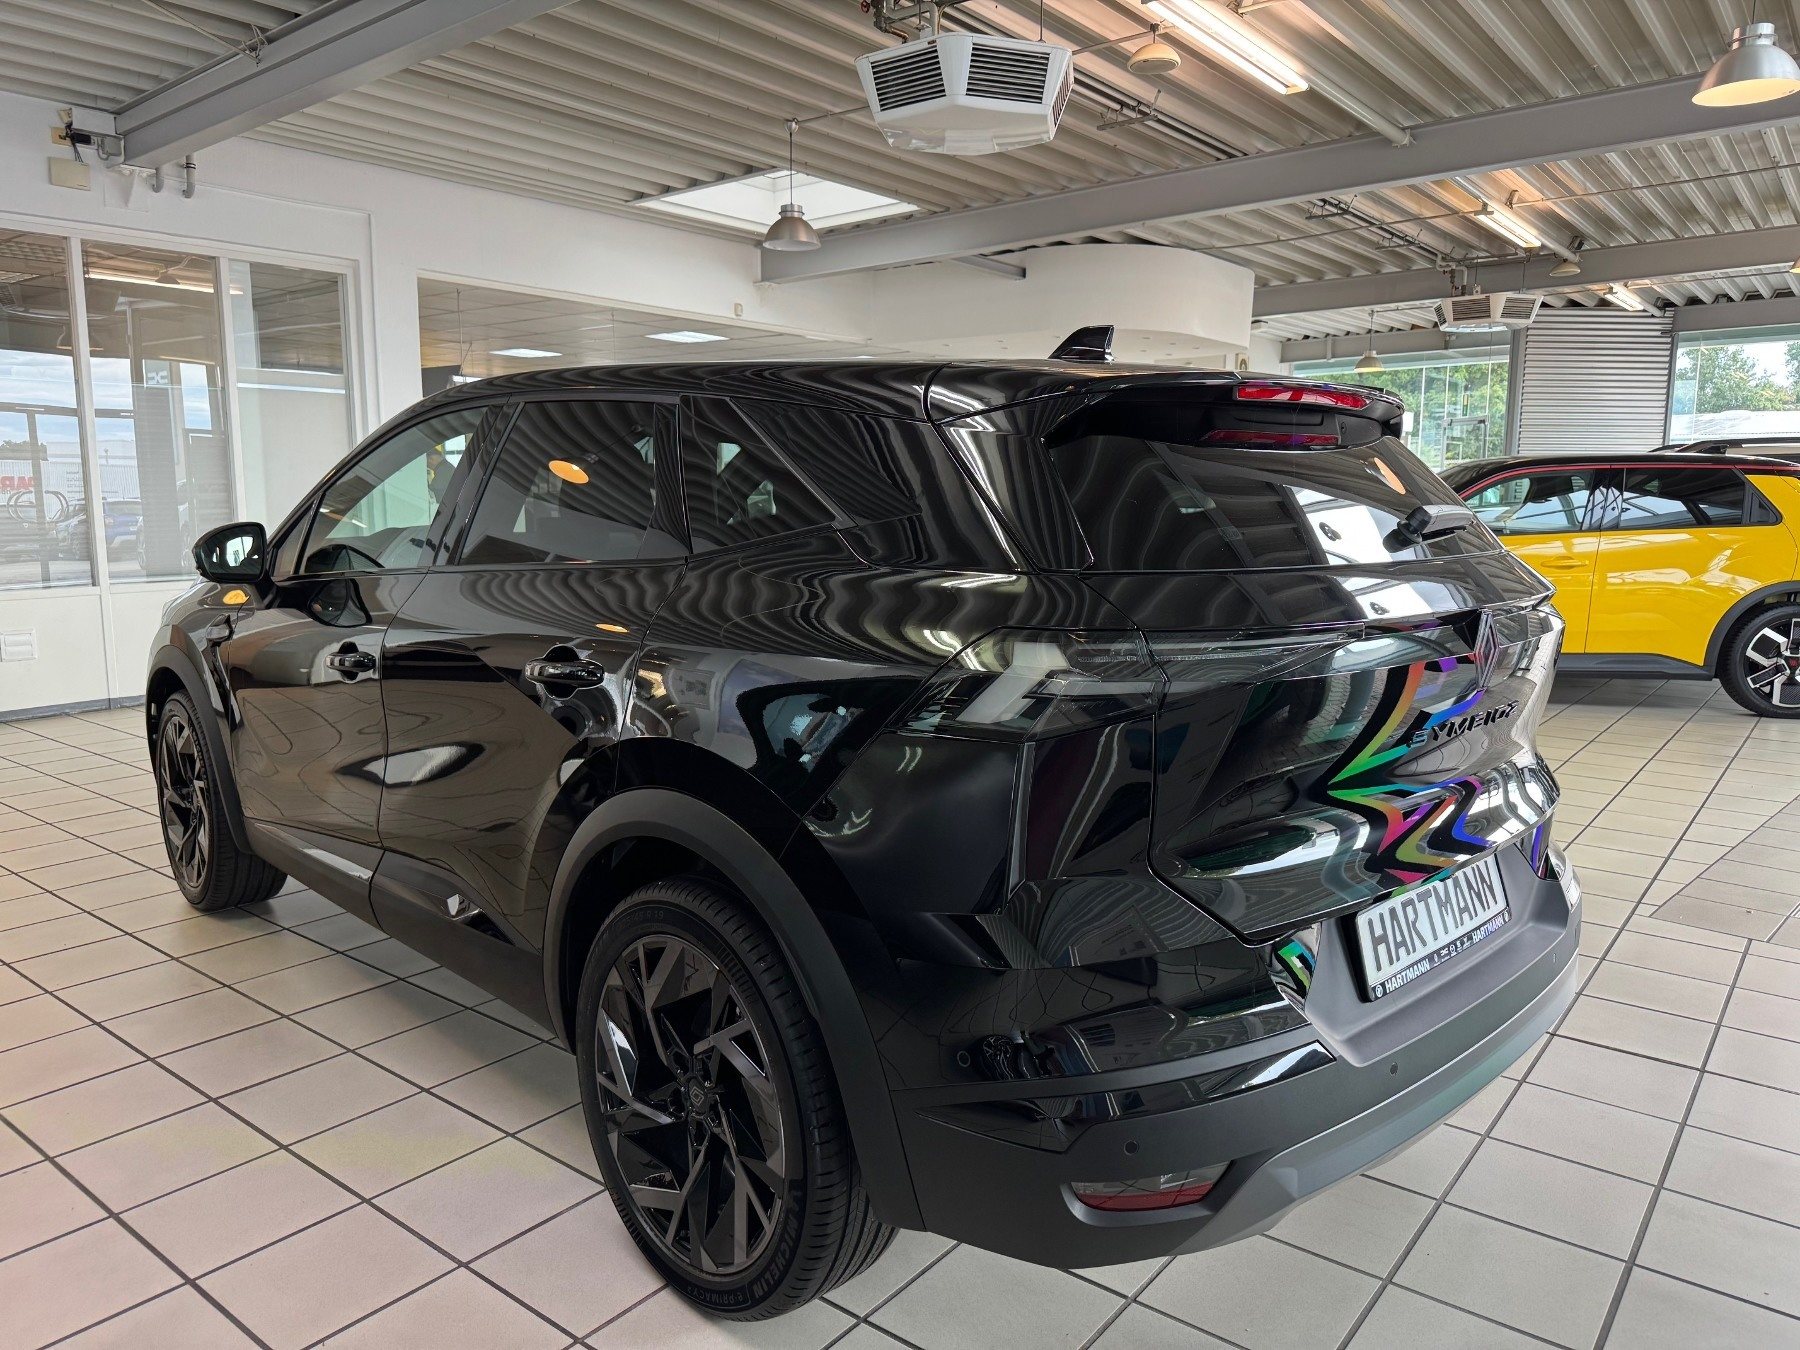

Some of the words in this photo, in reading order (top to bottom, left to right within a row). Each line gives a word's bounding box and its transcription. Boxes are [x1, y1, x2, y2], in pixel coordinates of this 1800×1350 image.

[1368, 860, 1498, 972] HARTMANN
[1472, 914, 1505, 943] HARTMANN
[1385, 959, 1431, 993] HARTMANN
